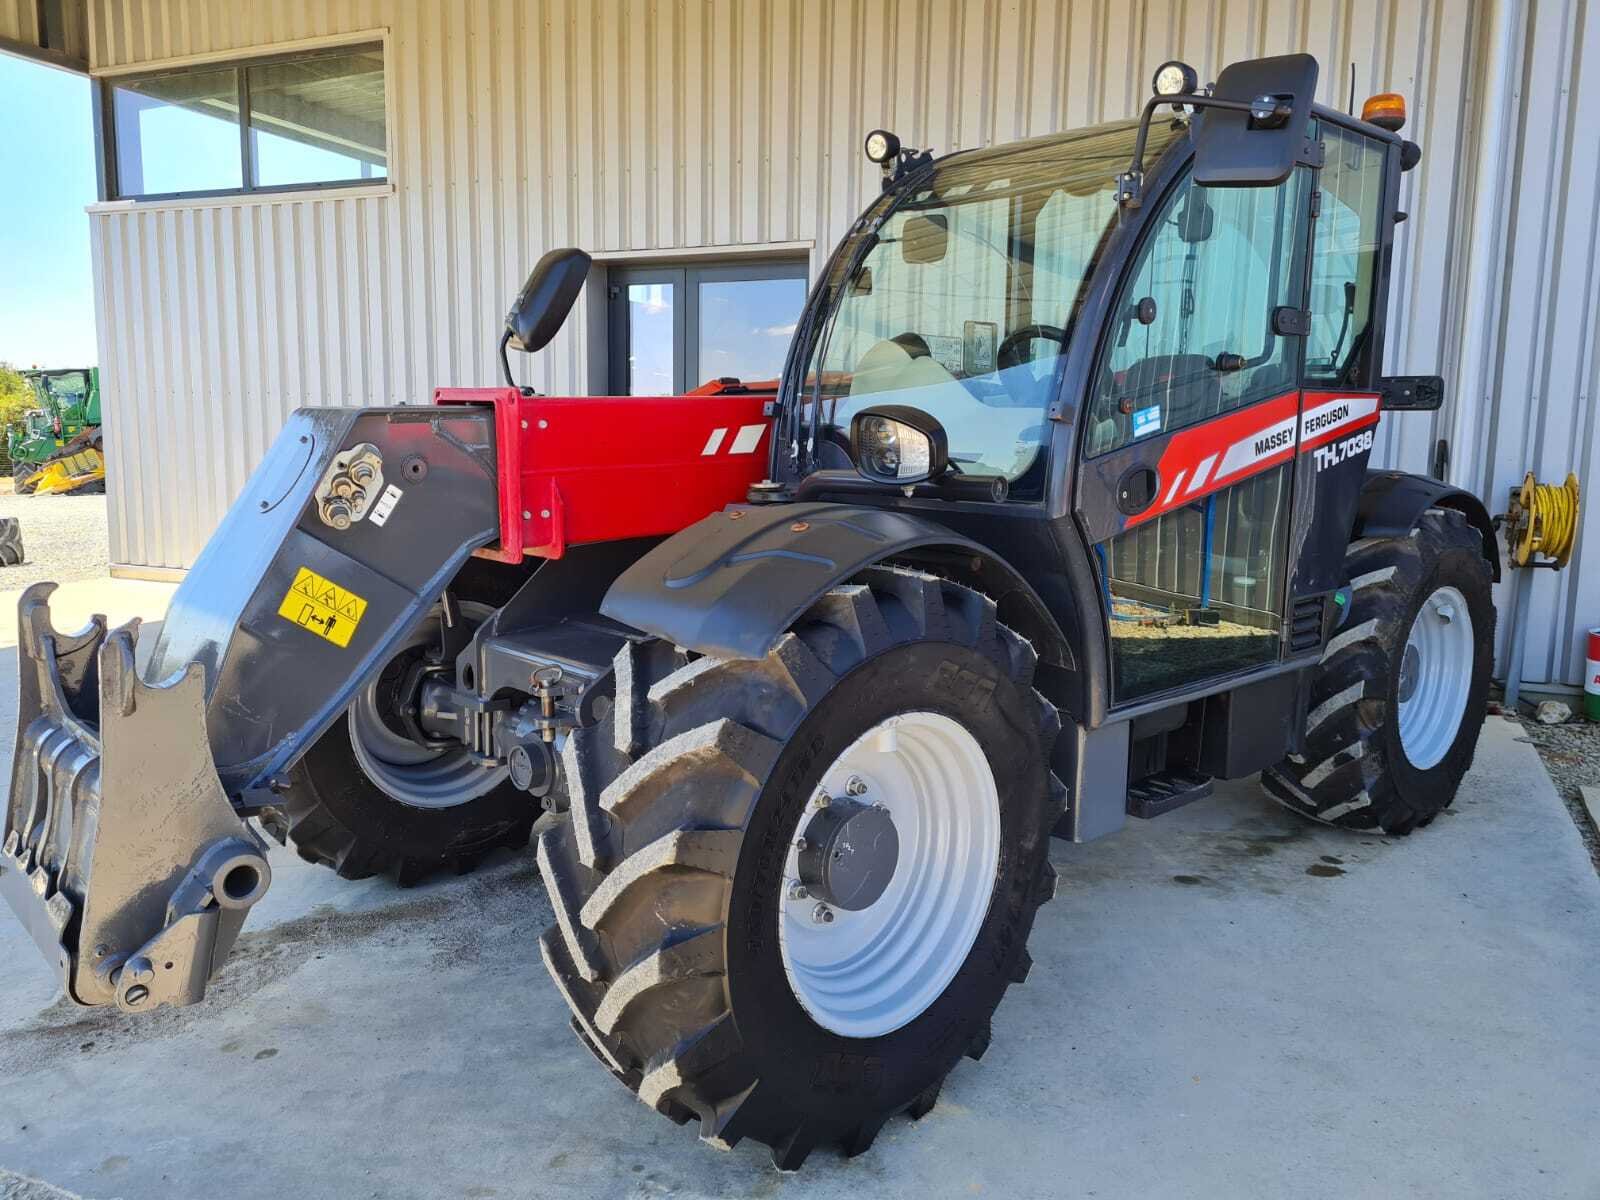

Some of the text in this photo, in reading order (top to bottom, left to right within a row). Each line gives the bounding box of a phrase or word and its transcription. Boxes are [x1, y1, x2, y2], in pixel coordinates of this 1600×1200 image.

[1254, 404, 1349, 456] MASSEY FERGUSON
[1313, 430, 1373, 472] TH.7038
